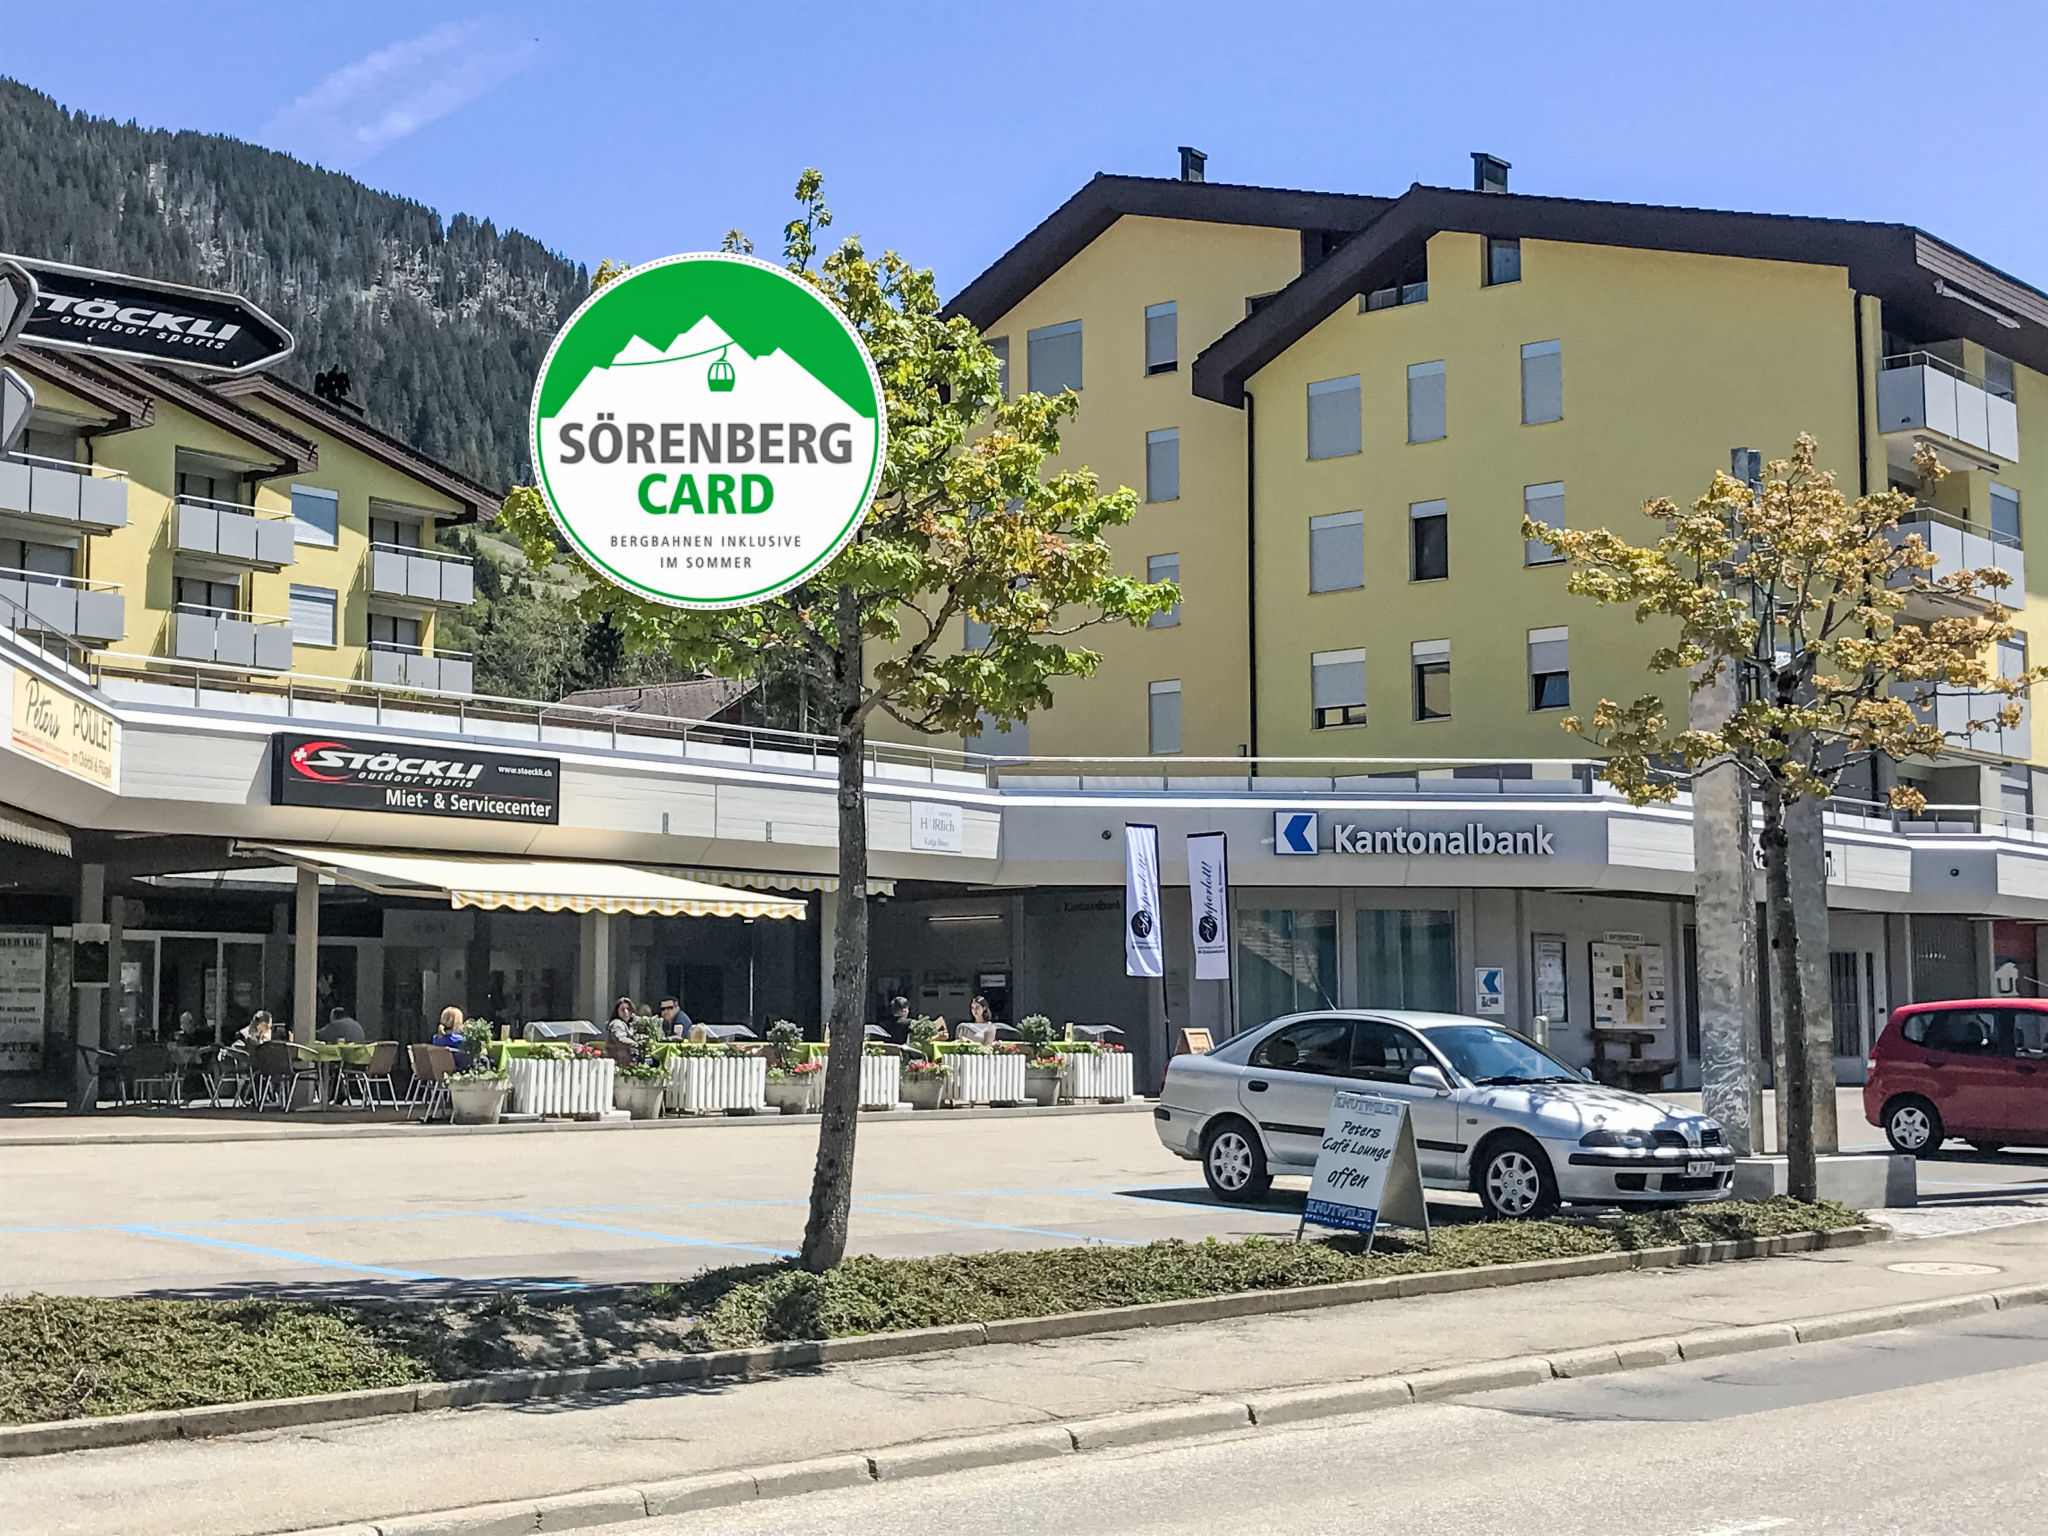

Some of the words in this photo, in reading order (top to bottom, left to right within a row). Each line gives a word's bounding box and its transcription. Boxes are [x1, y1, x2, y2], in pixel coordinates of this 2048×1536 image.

[60, 315, 149, 337] outdoor
[156, 329, 226, 350] sports
[26, 677, 60, 740] Peters
[73, 702, 113, 752] POULET
[303, 752, 484, 779] STÖCKLI
[497, 766, 553, 777] www.stoeckli.ch
[358, 770, 420, 784] outdoor
[425, 775, 474, 790] sports
[386, 788, 429, 808] Miet-
[433, 794, 446, 810] &
[450, 793, 552, 818] Servicecenter
[1333, 823, 1555, 856] Kantonalbank
[1341, 1121, 1382, 1138] Peters
[1322, 1137, 1350, 1154] Café
[1350, 1141, 1391, 1161] Lounge
[1327, 1167, 1369, 1188] offen
